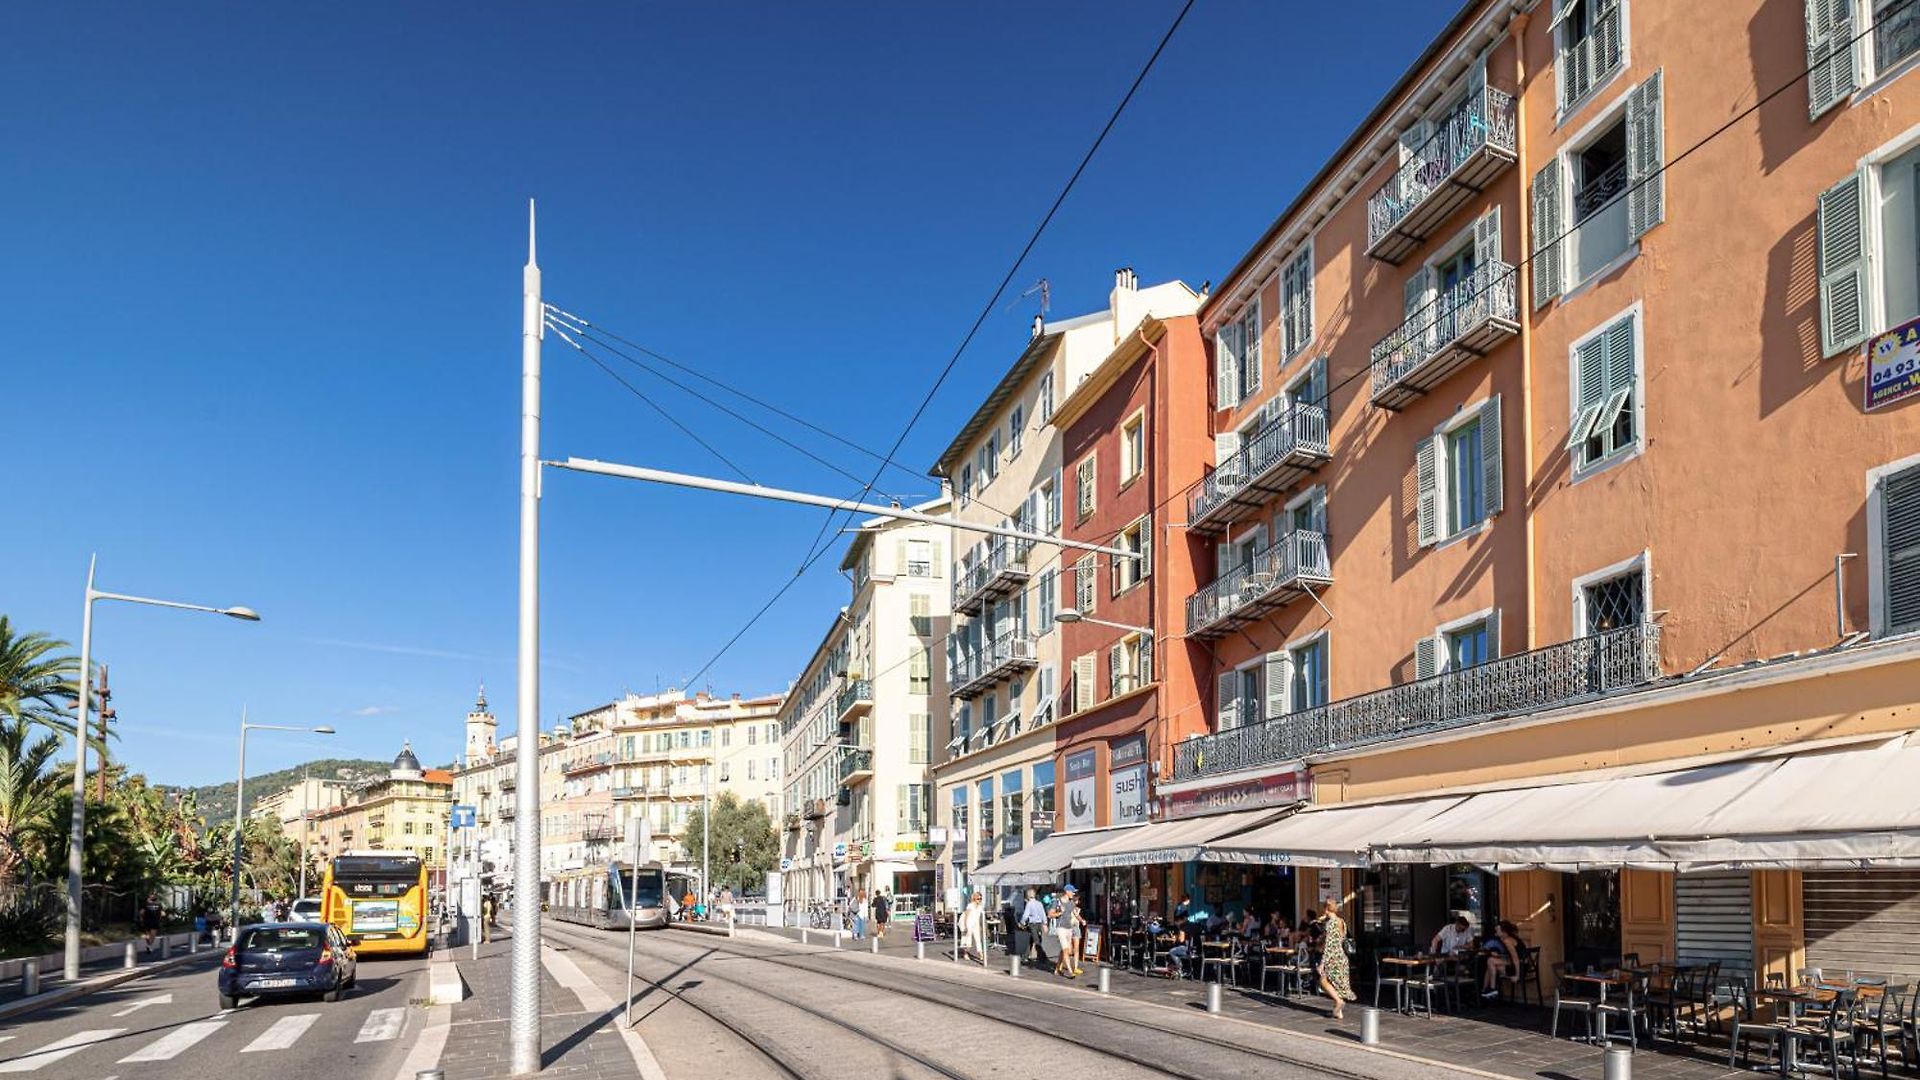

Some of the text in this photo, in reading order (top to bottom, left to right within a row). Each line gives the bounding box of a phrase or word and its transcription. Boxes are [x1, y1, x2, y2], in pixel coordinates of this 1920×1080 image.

[1873, 359, 1914, 383] 04 93
[1873, 383, 1902, 399] AGENCE
[1115, 770, 1146, 794] sushi
[1119, 800, 1143, 819] lune
[1258, 851, 1291, 862] HELIOS
